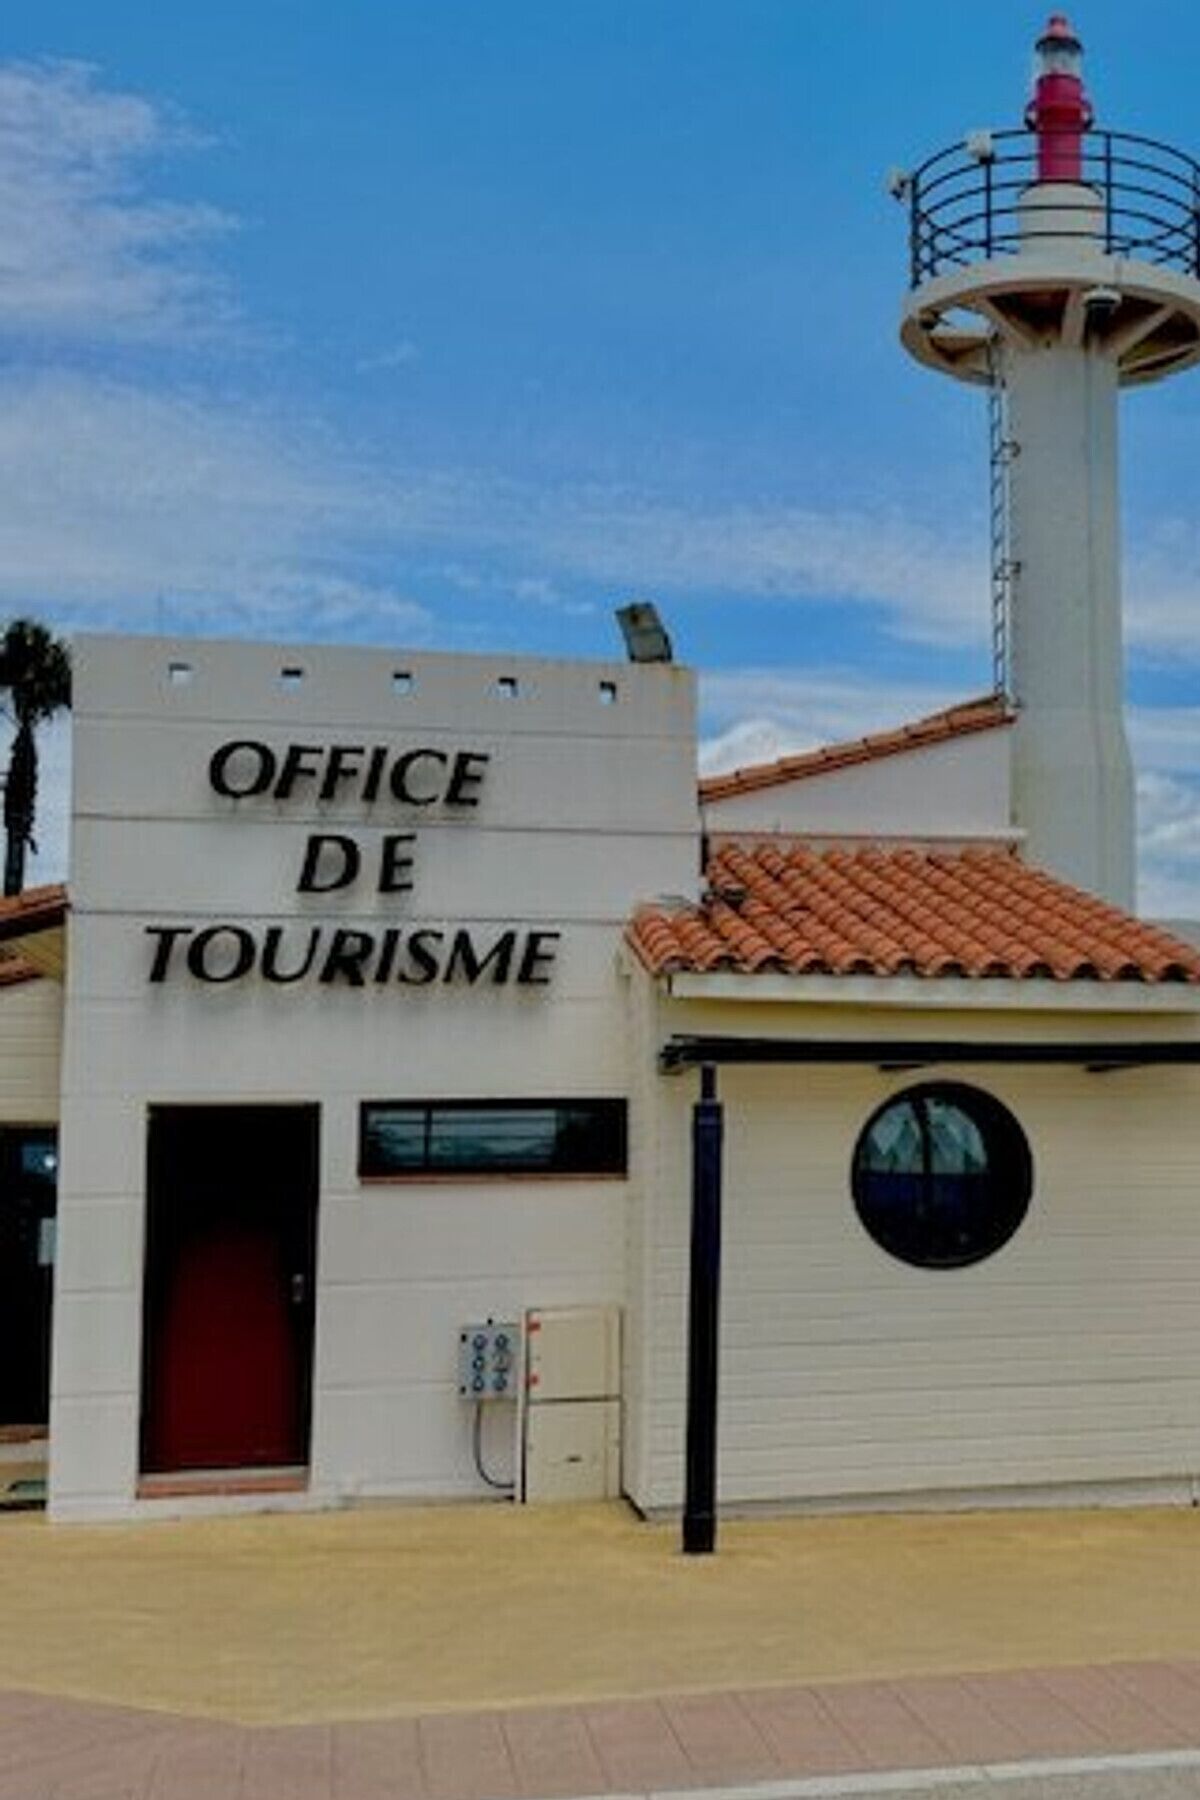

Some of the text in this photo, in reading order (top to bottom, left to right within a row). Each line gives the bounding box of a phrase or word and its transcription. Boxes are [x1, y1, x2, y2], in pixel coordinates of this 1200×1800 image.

[209, 741, 490, 808] OFFICE
[296, 833, 417, 895] DE
[145, 925, 561, 988] TOURISME
